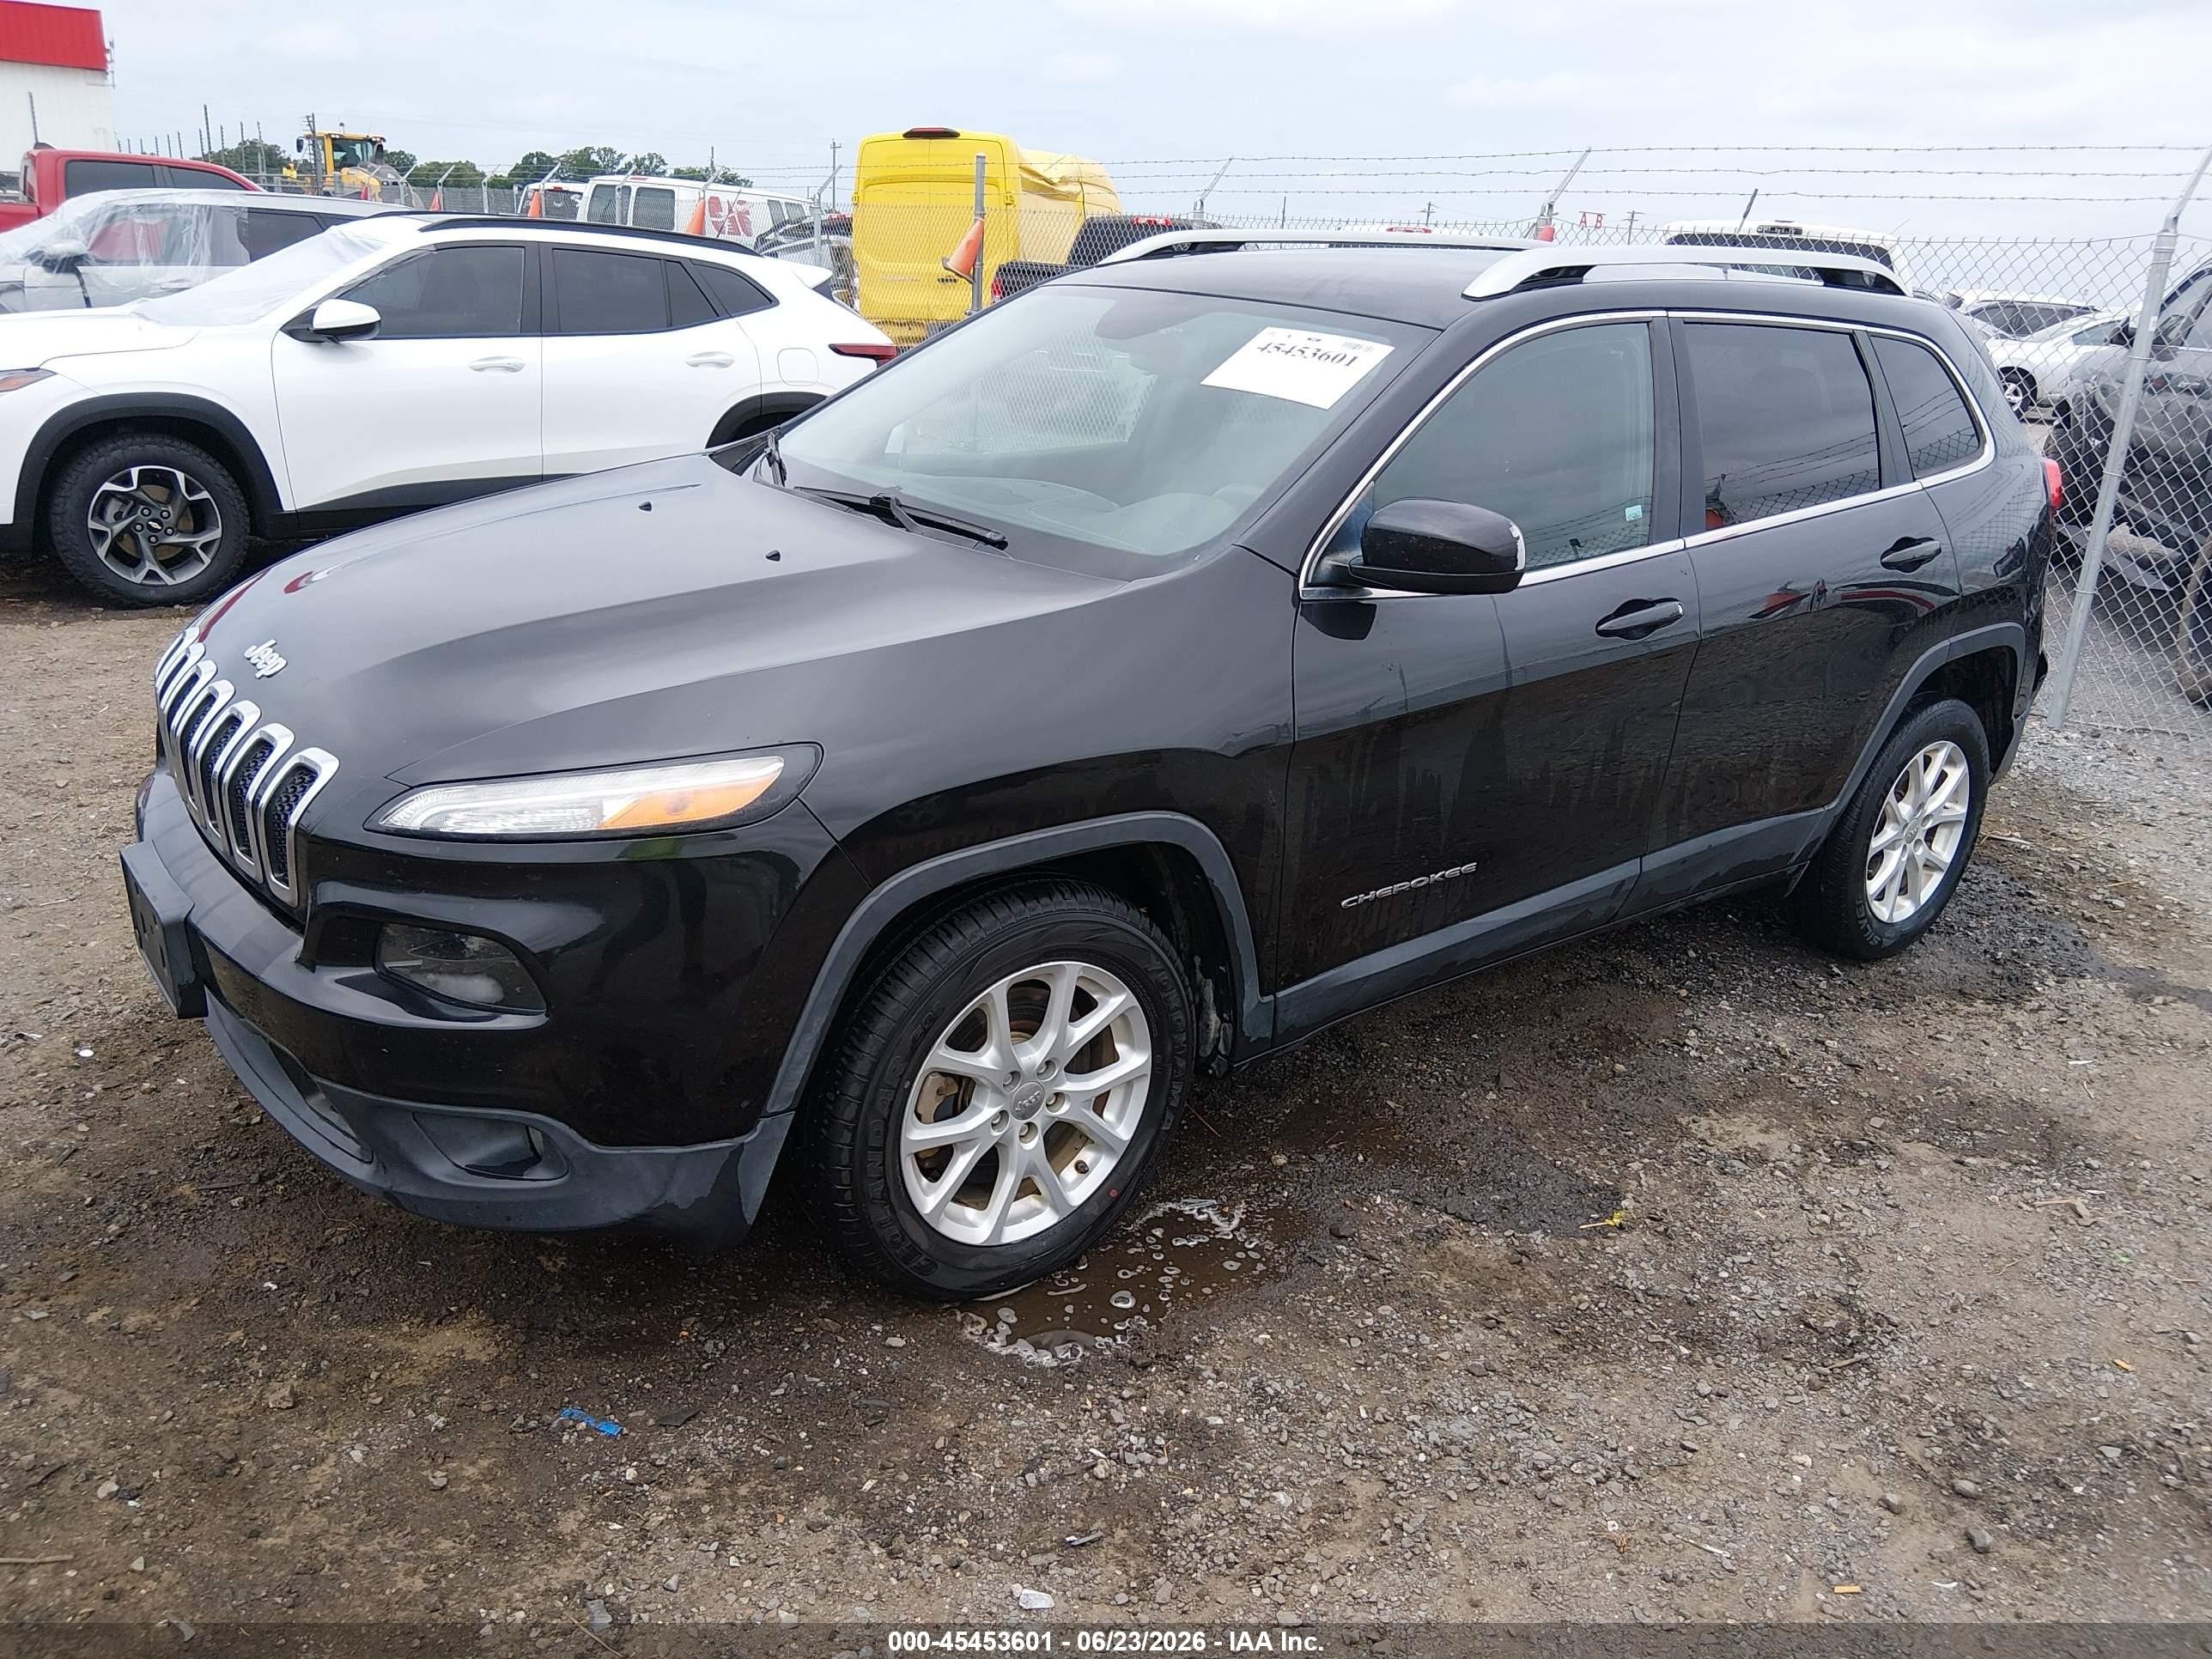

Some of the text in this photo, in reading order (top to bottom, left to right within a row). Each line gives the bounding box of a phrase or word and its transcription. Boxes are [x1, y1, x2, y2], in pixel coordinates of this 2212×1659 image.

[1579, 212, 1603, 229] A B
[1256, 342, 1358, 368] 45453601
[243, 638, 288, 679] Jeep
[1340, 861, 1478, 908] CHEROKEE
[1146, 954, 1188, 1129] YOKOHAMA
